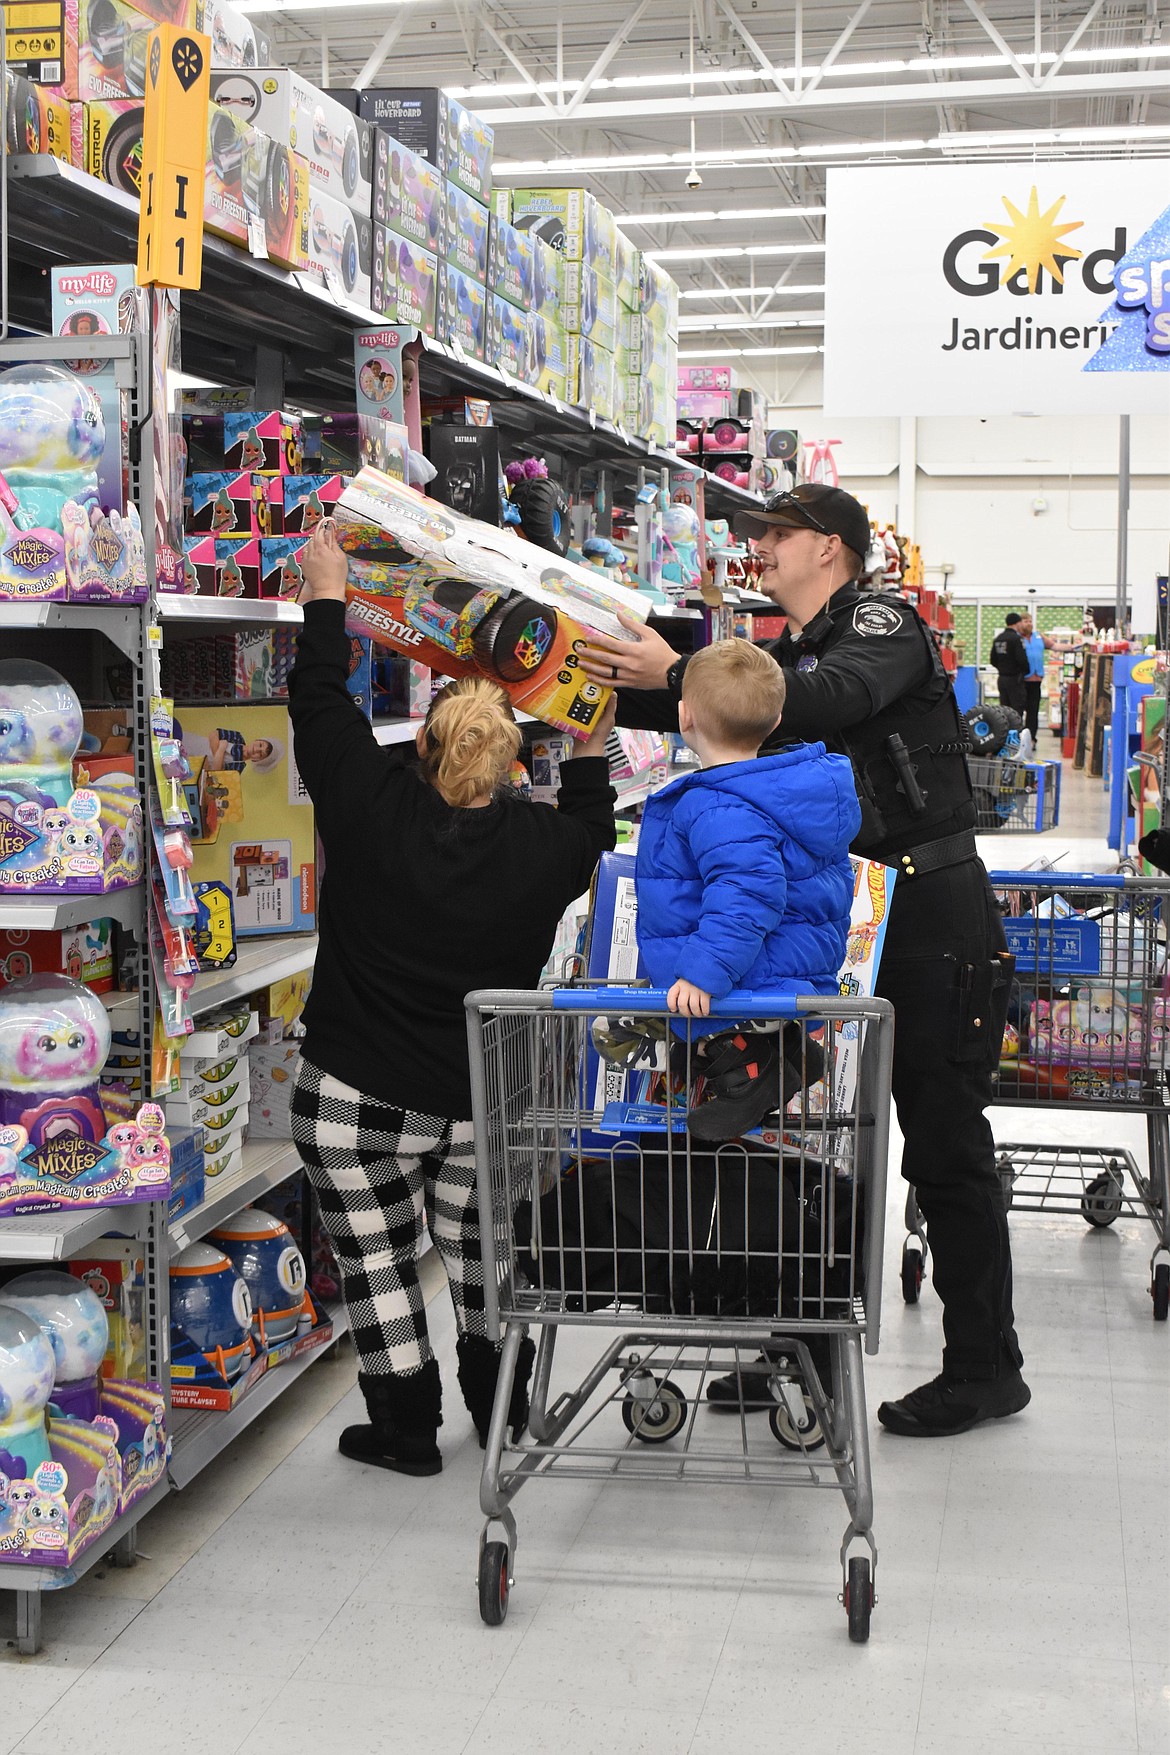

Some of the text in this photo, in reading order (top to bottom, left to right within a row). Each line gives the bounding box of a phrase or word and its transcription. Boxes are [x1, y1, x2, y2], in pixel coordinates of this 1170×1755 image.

[375, 108, 421, 118] HOVERBOARD
[93, 120, 101, 179] AGTRON
[519, 205, 566, 213] HOVERBOARD
[174, 237, 185, 276] 1
[454, 435, 477, 443] BATMAN
[18, 541, 43, 551] Magic
[17, 572, 58, 594] Create?
[347, 600, 425, 646] FREESTYLE
[586, 686, 597, 697] 5
[75, 791, 95, 800] 80+
[14, 857, 64, 884] Create?
[302, 867, 310, 911] nickelodeon
[213, 896, 218, 905] 1
[218, 920, 225, 929] 2
[215, 943, 222, 952] 3
[48, 1138, 86, 1153] Magic
[20, 1184, 35, 1194] you
[36, 1180, 81, 1199] Magically
[83, 1168, 134, 1198] Create?
[42, 1462, 61, 1472] 80+
